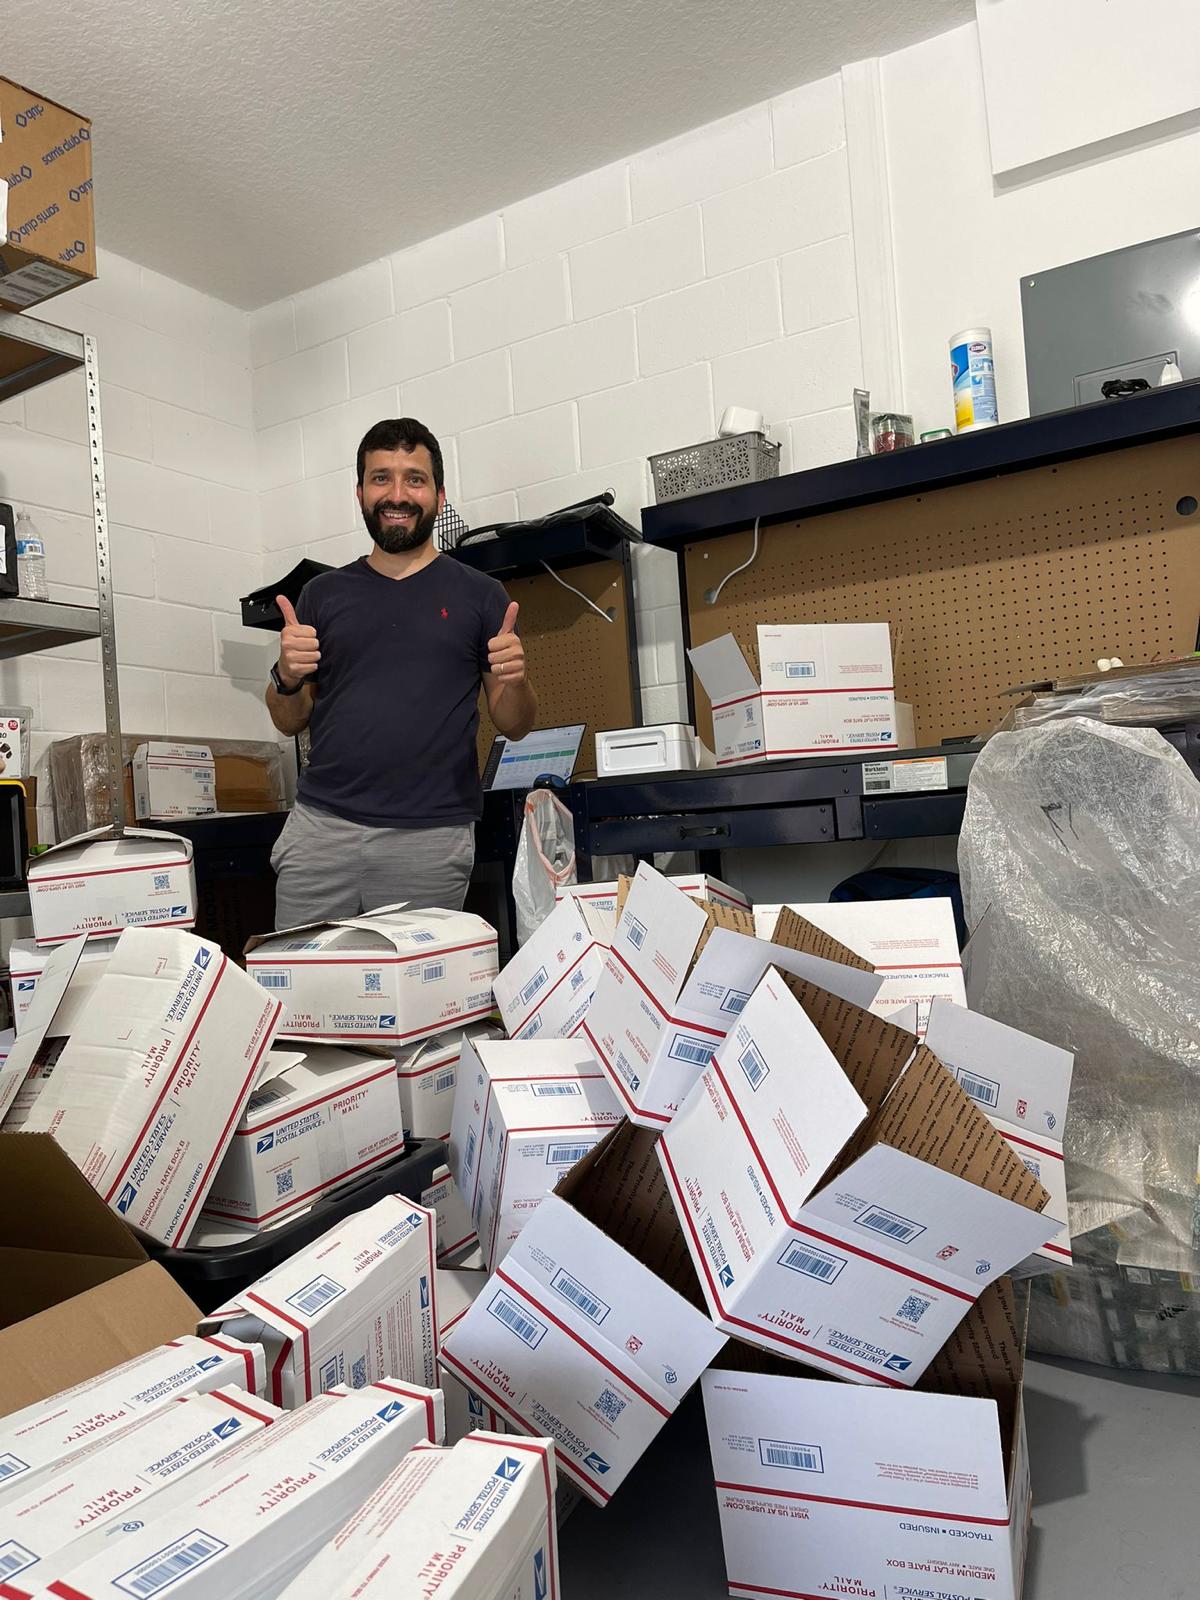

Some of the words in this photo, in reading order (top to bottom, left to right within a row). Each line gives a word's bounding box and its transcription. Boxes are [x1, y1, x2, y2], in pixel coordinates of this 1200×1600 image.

[42, 146, 64, 165] sam's
[63, 135, 80, 151] club
[37, 203, 60, 224] sam's
[20, 218, 38, 236] club
[75, 919, 112, 929] PRIORITY
[125, 909, 149, 918] SERVICE
[180, 964, 197, 990] POSTAL
[187, 970, 204, 997] UNITED
[165, 989, 185, 1020] SERVICE
[175, 996, 192, 1022] STATES
[140, 1045, 157, 1070] MAIL
[143, 1038, 171, 1084] PRIORITY
[172, 1044, 201, 1095] PRIORITY
[184, 1060, 201, 1088] MAIL
[331, 1090, 366, 1111] PRIORITY
[340, 1102, 359, 1114] MAIL
[274, 1120, 298, 1136] UNITED
[298, 1111, 320, 1126] STATES
[274, 1126, 302, 1145] POSTAL
[302, 1118, 322, 1133] SERVICE
[129, 1145, 151, 1180] UNITED
[147, 1113, 167, 1146] STATES
[135, 1154, 156, 1187] POSTAL
[151, 1116, 174, 1154] SERVICE
[138, 1184, 163, 1227] REGIONAL
[159, 1164, 173, 1185] RATE
[169, 1145, 182, 1164] BOX
[691, 1177, 703, 1197] MAIL
[745, 1164, 762, 1192] INSURED
[162, 1202, 186, 1241] TRACKED
[183, 1162, 205, 1198] INSURED
[684, 1177, 701, 1212] PRIORITY
[719, 1189, 729, 1204] BOX
[724, 1202, 735, 1218] RATE
[758, 1193, 777, 1225] TRACKED
[700, 1224, 713, 1245] STATES
[705, 1215, 719, 1240] SERVICE
[731, 1219, 741, 1234] FLAT
[353, 1248, 370, 1262] MAIL
[354, 1248, 382, 1272] PRIORITY
[708, 1243, 722, 1270] UNITED
[714, 1238, 729, 1264] POSTAL
[737, 1234, 752, 1262] MEDIUM
[761, 1311, 810, 1336] PRIORITY
[778, 1308, 805, 1324] MAIL
[825, 1338, 854, 1354] STATES
[830, 1329, 861, 1346] SERVICE
[860, 1340, 890, 1357] POSTAL
[854, 1349, 883, 1365] UNITED
[166, 1364, 195, 1383] POSTAL
[173, 1368, 202, 1388] UNITED
[472, 1357, 515, 1398] PRIORITY
[486, 1360, 510, 1381] MAIL
[133, 1380, 166, 1401] SERVICE
[143, 1384, 173, 1404] STATES
[65, 1408, 126, 1443] PRIORITY
[72, 1411, 105, 1432] MAIL
[347, 1414, 377, 1438] POSTAL
[529, 1410, 556, 1435] STATES
[533, 1401, 564, 1429] SERVICE
[180, 1430, 212, 1453] POSTAL
[356, 1420, 385, 1444] UNITED
[561, 1426, 590, 1452] POSTAL
[188, 1436, 220, 1460] UNITED
[318, 1434, 350, 1461] SERVICE
[330, 1440, 359, 1464] STATES
[554, 1431, 583, 1458] UNITED
[146, 1448, 182, 1474] SERVICE
[158, 1455, 189, 1478] STATES
[257, 1470, 316, 1513] PRIORITY
[261, 1474, 294, 1500] MAIL
[475, 1475, 498, 1503] POSTAL
[488, 1480, 512, 1509] UNITED
[77, 1484, 142, 1526] PRIORITY
[82, 1487, 117, 1512] MAIL
[725, 1501, 765, 1513] USPS.COM
[767, 1507, 779, 1515] AT
[456, 1500, 481, 1530] SERVICE
[472, 1506, 494, 1532] STATES
[780, 1508, 788, 1517] US
[790, 1510, 809, 1520] VISIT
[898, 1521, 939, 1534] INSURED
[948, 1527, 993, 1540] TRACKED
[416, 1549, 444, 1581] MAIL
[421, 1542, 466, 1597] PRIORITY
[885, 1558, 905, 1568] BOX
[907, 1561, 930, 1571] RATE
[932, 1564, 954, 1575] FLAT
[956, 1567, 995, 1580] MEDIUM
[821, 1582, 875, 1597] PRIORITY
[833, 1575, 861, 1585] MAIL
